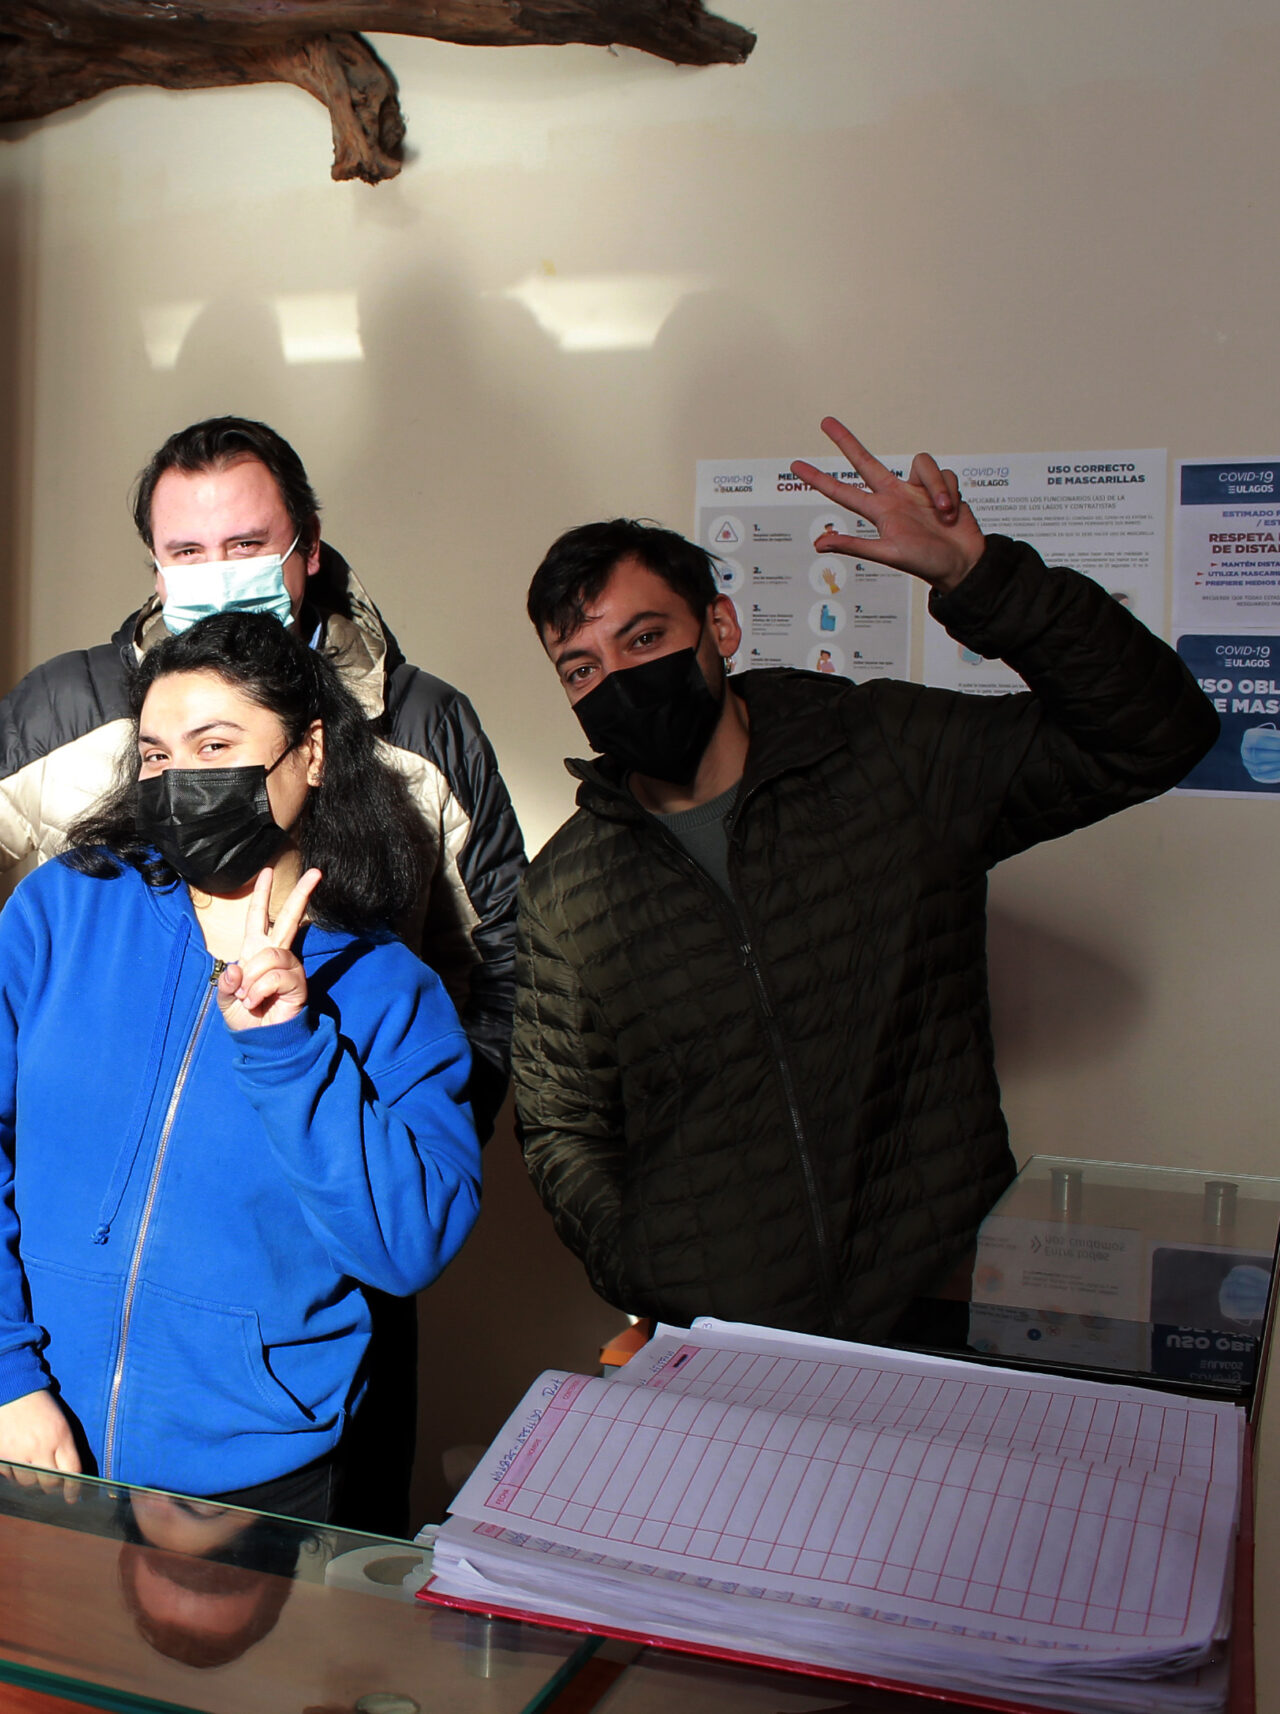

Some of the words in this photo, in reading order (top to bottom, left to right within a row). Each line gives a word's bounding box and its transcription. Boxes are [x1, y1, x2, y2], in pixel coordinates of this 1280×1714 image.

[962, 467, 1010, 478] COVID-19
[1047, 465, 1070, 474] USO
[1073, 463, 1136, 473] CORRECTO
[713, 474, 753, 484] COVID-19
[1047, 477, 1063, 486] DE
[1065, 474, 1146, 485] MASCARILLAS
[1219, 471, 1274, 483] COVID-19
[977, 479, 1010, 487] ULAGOS
[726, 485, 753, 493] ULAGOS
[1236, 485, 1274, 494] ULAGOS
[1209, 533, 1275, 542] RESPETA
[1212, 545, 1231, 554] DE
[1235, 544, 1280, 554] DISTA
[1215, 645, 1270, 658] COVID-19
[1233, 659, 1270, 668] ULAGOS
[1231, 699, 1280, 714] MAS
